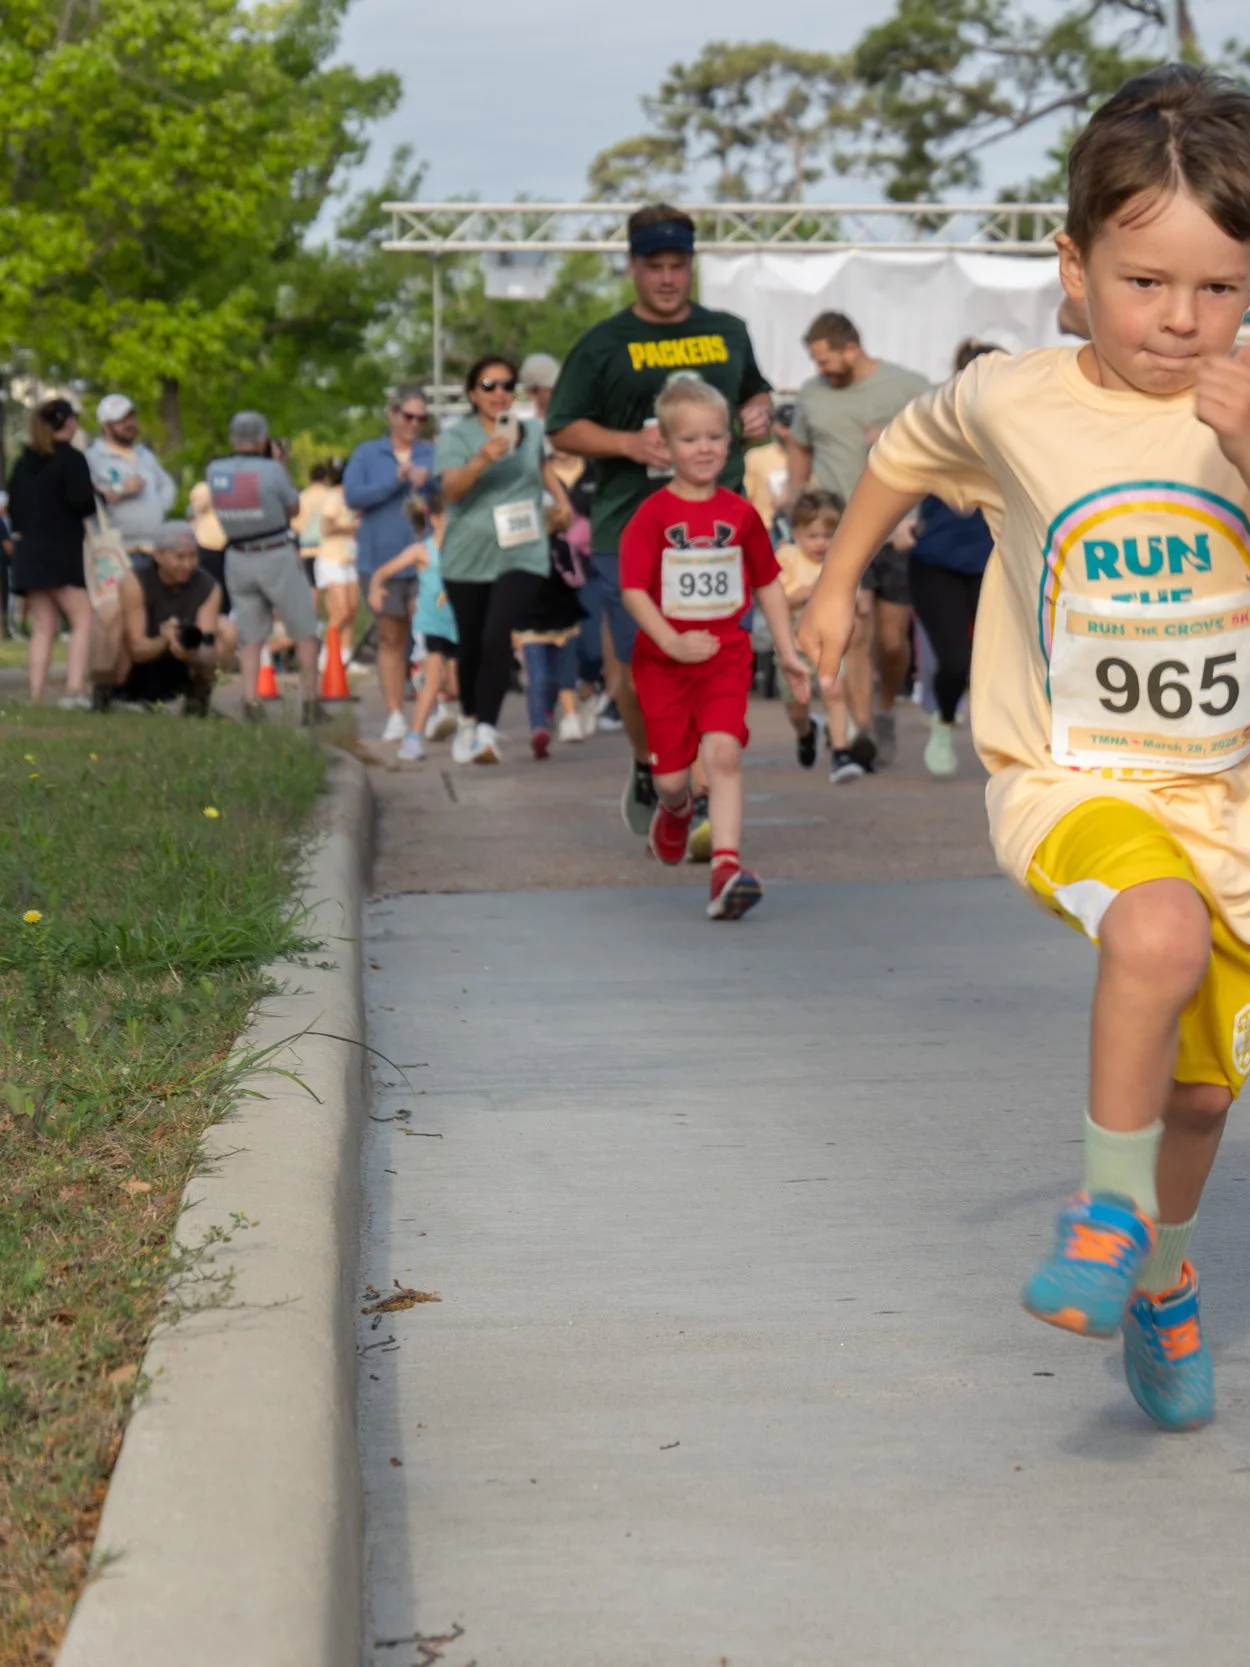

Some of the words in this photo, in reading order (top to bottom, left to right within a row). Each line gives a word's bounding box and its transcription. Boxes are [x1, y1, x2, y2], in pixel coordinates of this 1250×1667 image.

[628, 334, 730, 371] PACKERS
[1083, 532, 1212, 581] RUN
[679, 570, 729, 597] 938
[1087, 620, 1125, 636] RUN
[1134, 626, 1158, 637] THE
[1095, 651, 1240, 720] 965
[1090, 734, 1128, 747] TMNA
[1143, 737, 1183, 753] March
